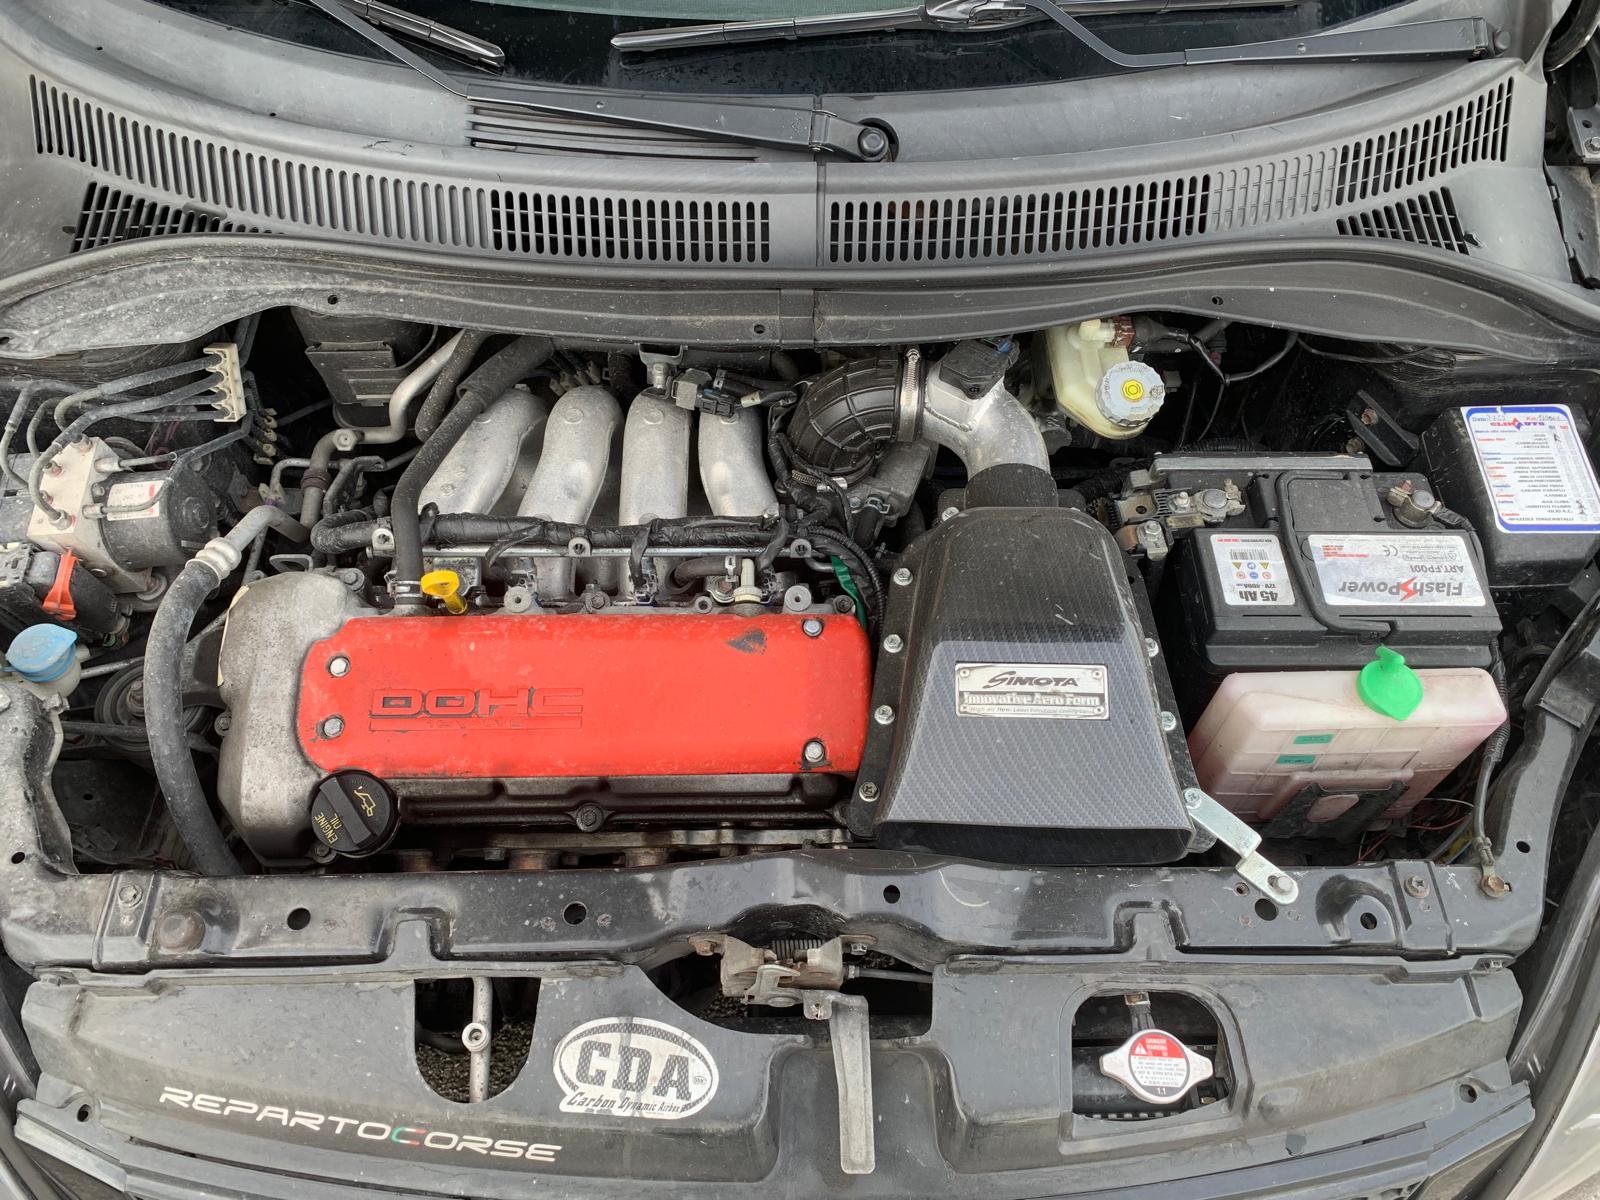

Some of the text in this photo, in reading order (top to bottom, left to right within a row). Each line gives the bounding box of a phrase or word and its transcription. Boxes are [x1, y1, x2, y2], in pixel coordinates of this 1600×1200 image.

[1238, 591, 1278, 601] 45 Ah
[1338, 582, 1463, 596] Flash Power
[982, 671, 1079, 689] SIMOTA
[370, 687, 584, 717] DOHC
[963, 692, 1100, 706] Innovative Aero Form
[314, 811, 339, 844] ENGINE
[330, 812, 342, 830] OIL
[575, 1039, 692, 1101] CDA
[1157, 1087, 1166, 1095] 1.1
[567, 1091, 617, 1110] Carbon
[617, 1096, 656, 1112] Dynamic
[159, 1086, 562, 1162] REPARTOCORSE
